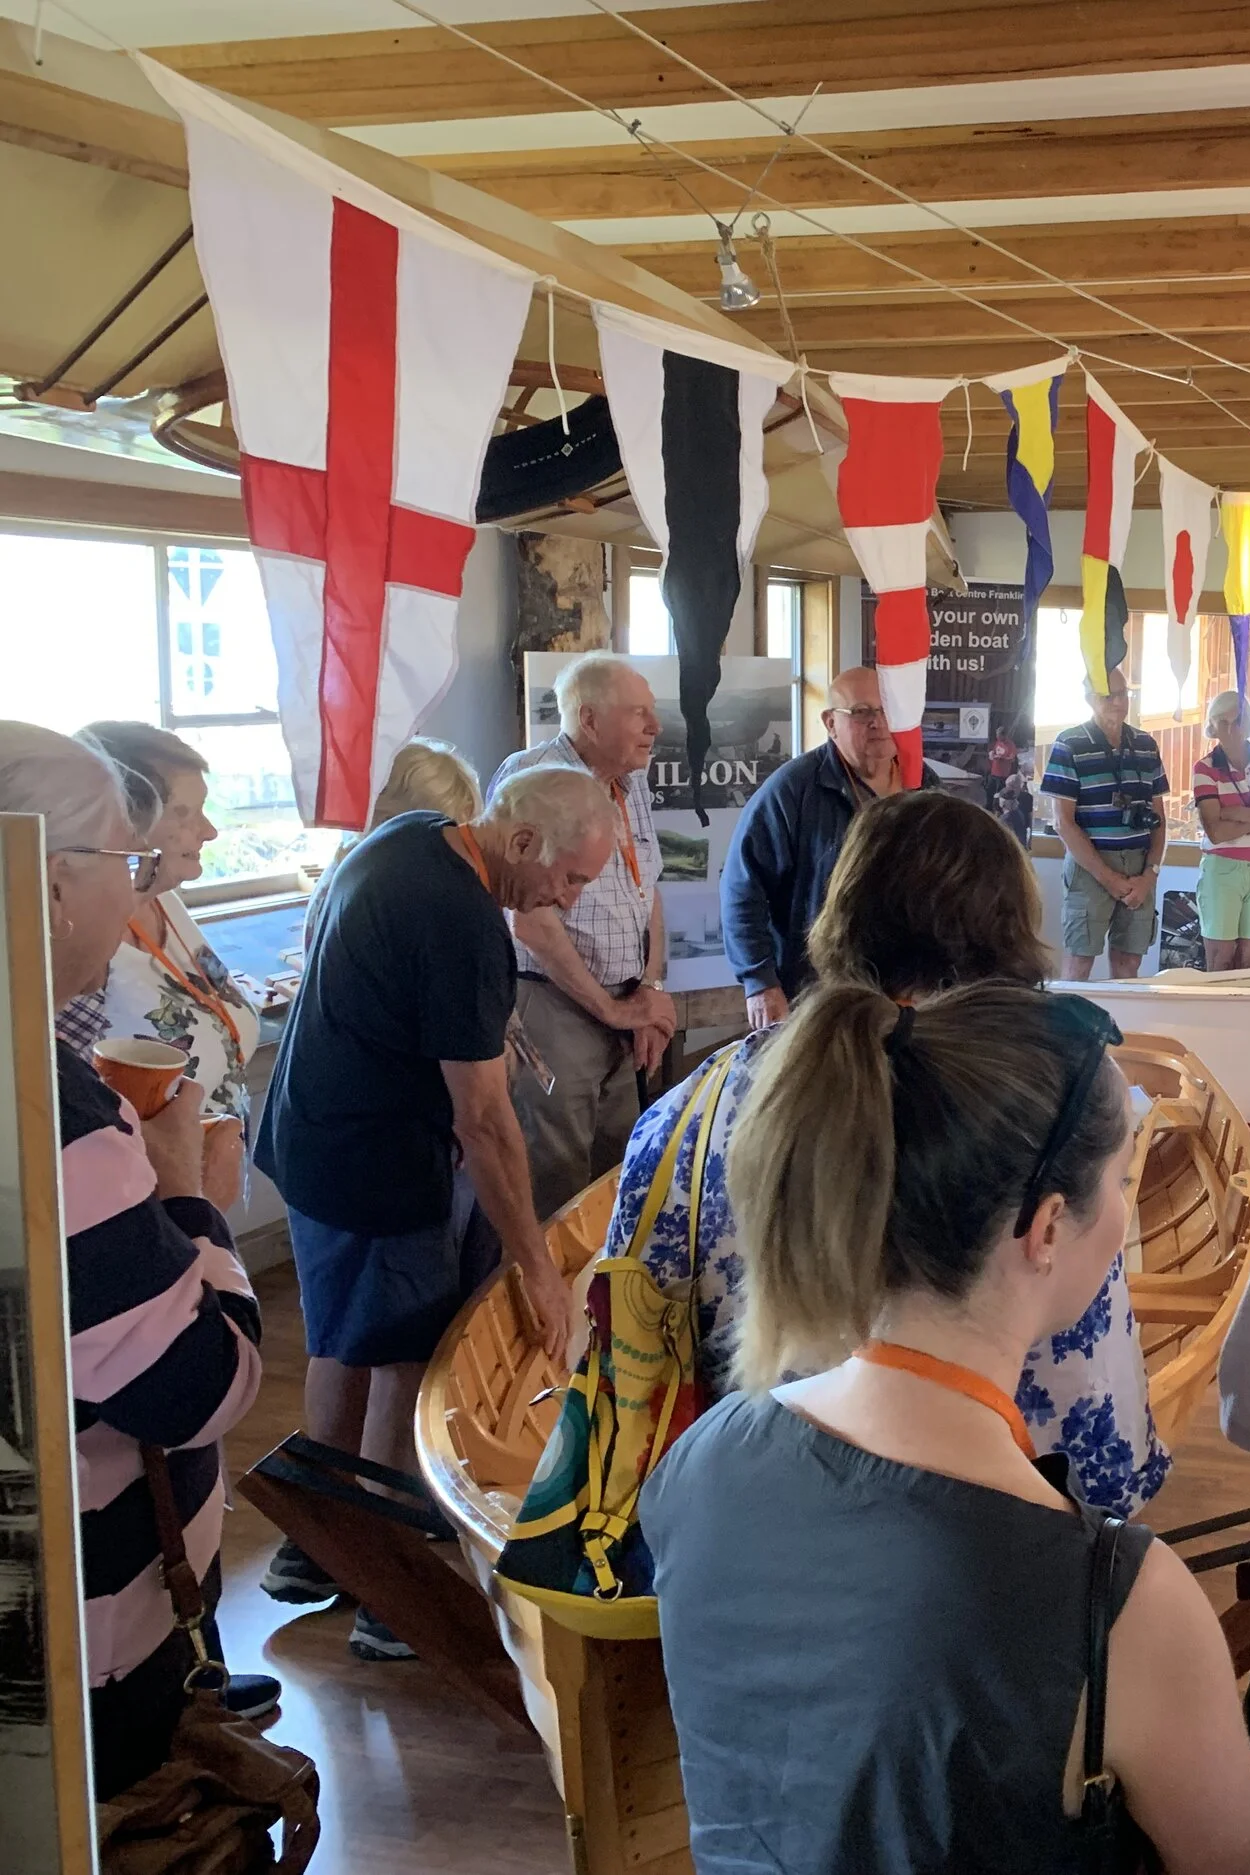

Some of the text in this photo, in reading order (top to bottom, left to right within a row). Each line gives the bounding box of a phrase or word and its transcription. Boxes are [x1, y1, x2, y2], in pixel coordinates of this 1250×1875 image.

[932, 610, 1019, 627] your own
[930, 630, 1009, 648] den boat
[927, 655, 985, 671] ith us!
[649, 755, 760, 788] ILON
